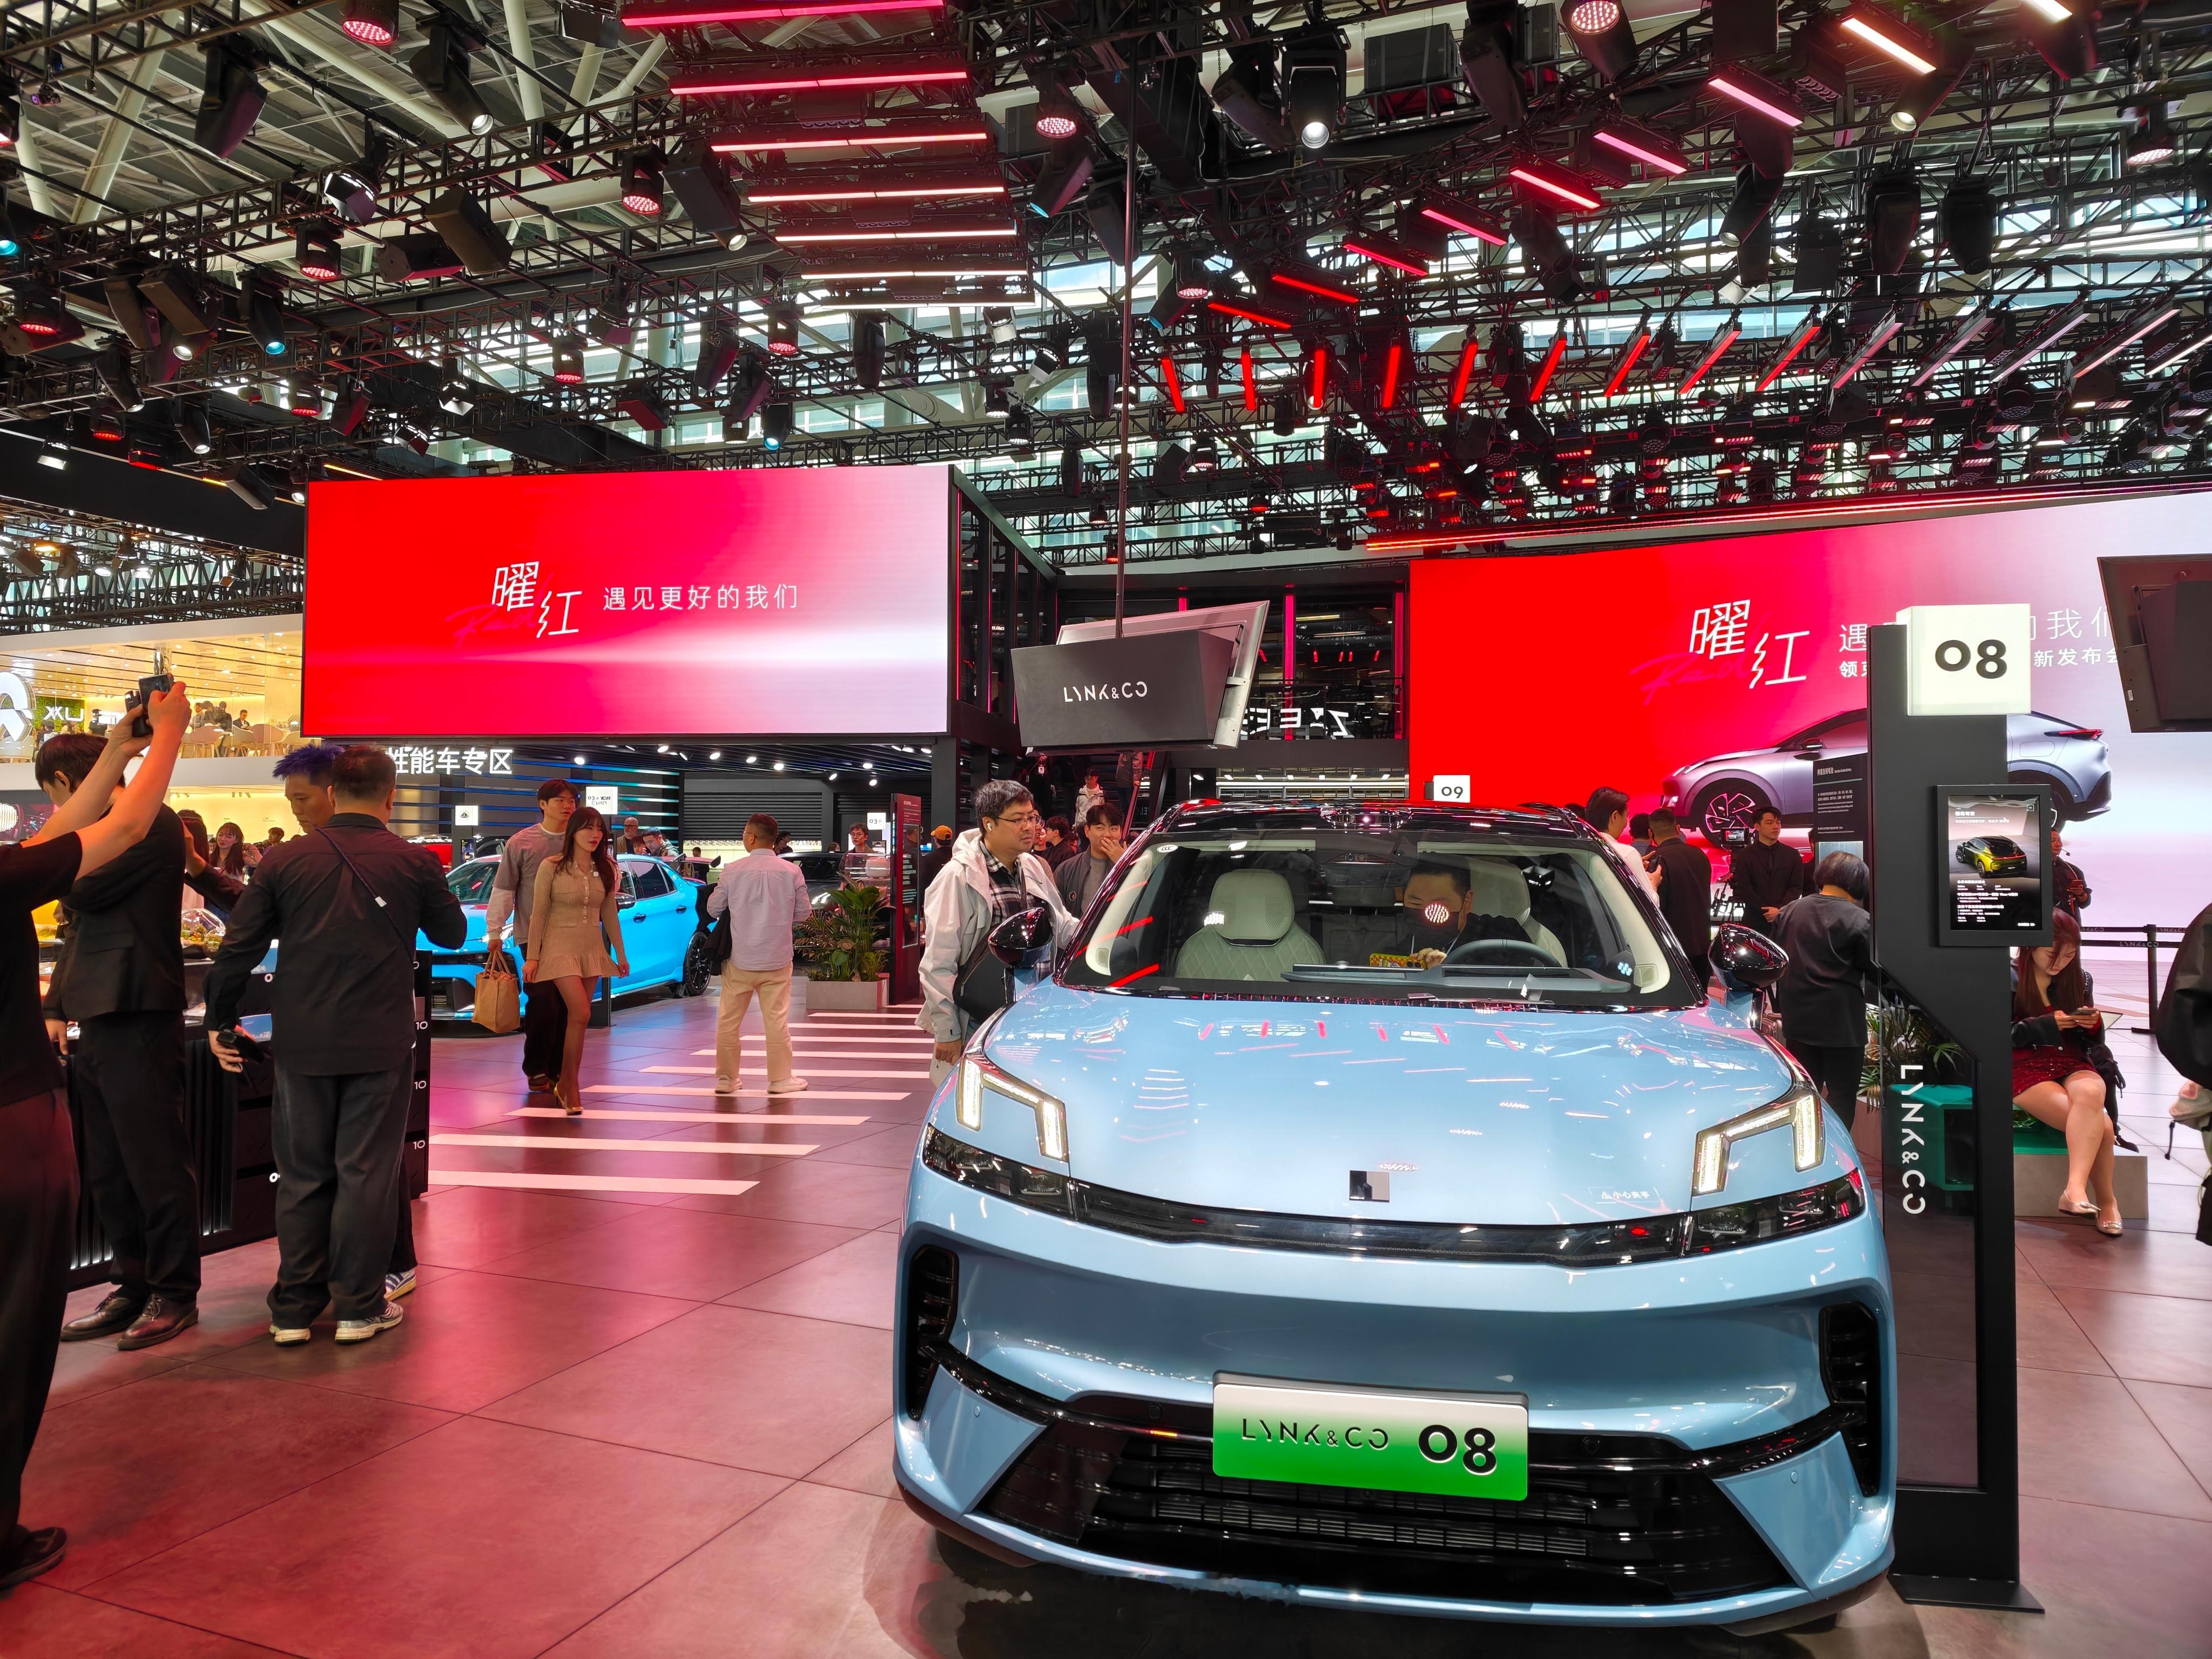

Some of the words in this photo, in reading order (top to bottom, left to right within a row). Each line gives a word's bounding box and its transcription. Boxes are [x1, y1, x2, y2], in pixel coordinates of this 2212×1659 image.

[603, 583, 797, 610] 遇见更好的我们
[1934, 639, 2008, 679] 08
[385, 746, 514, 775] 性能车专区
[1441, 786, 1464, 799] 09
[415, 1021, 428, 1030] 10
[414, 1080, 427, 1090] 10
[413, 1139, 426, 1150] 10
[1418, 1424, 1498, 1476] 08
